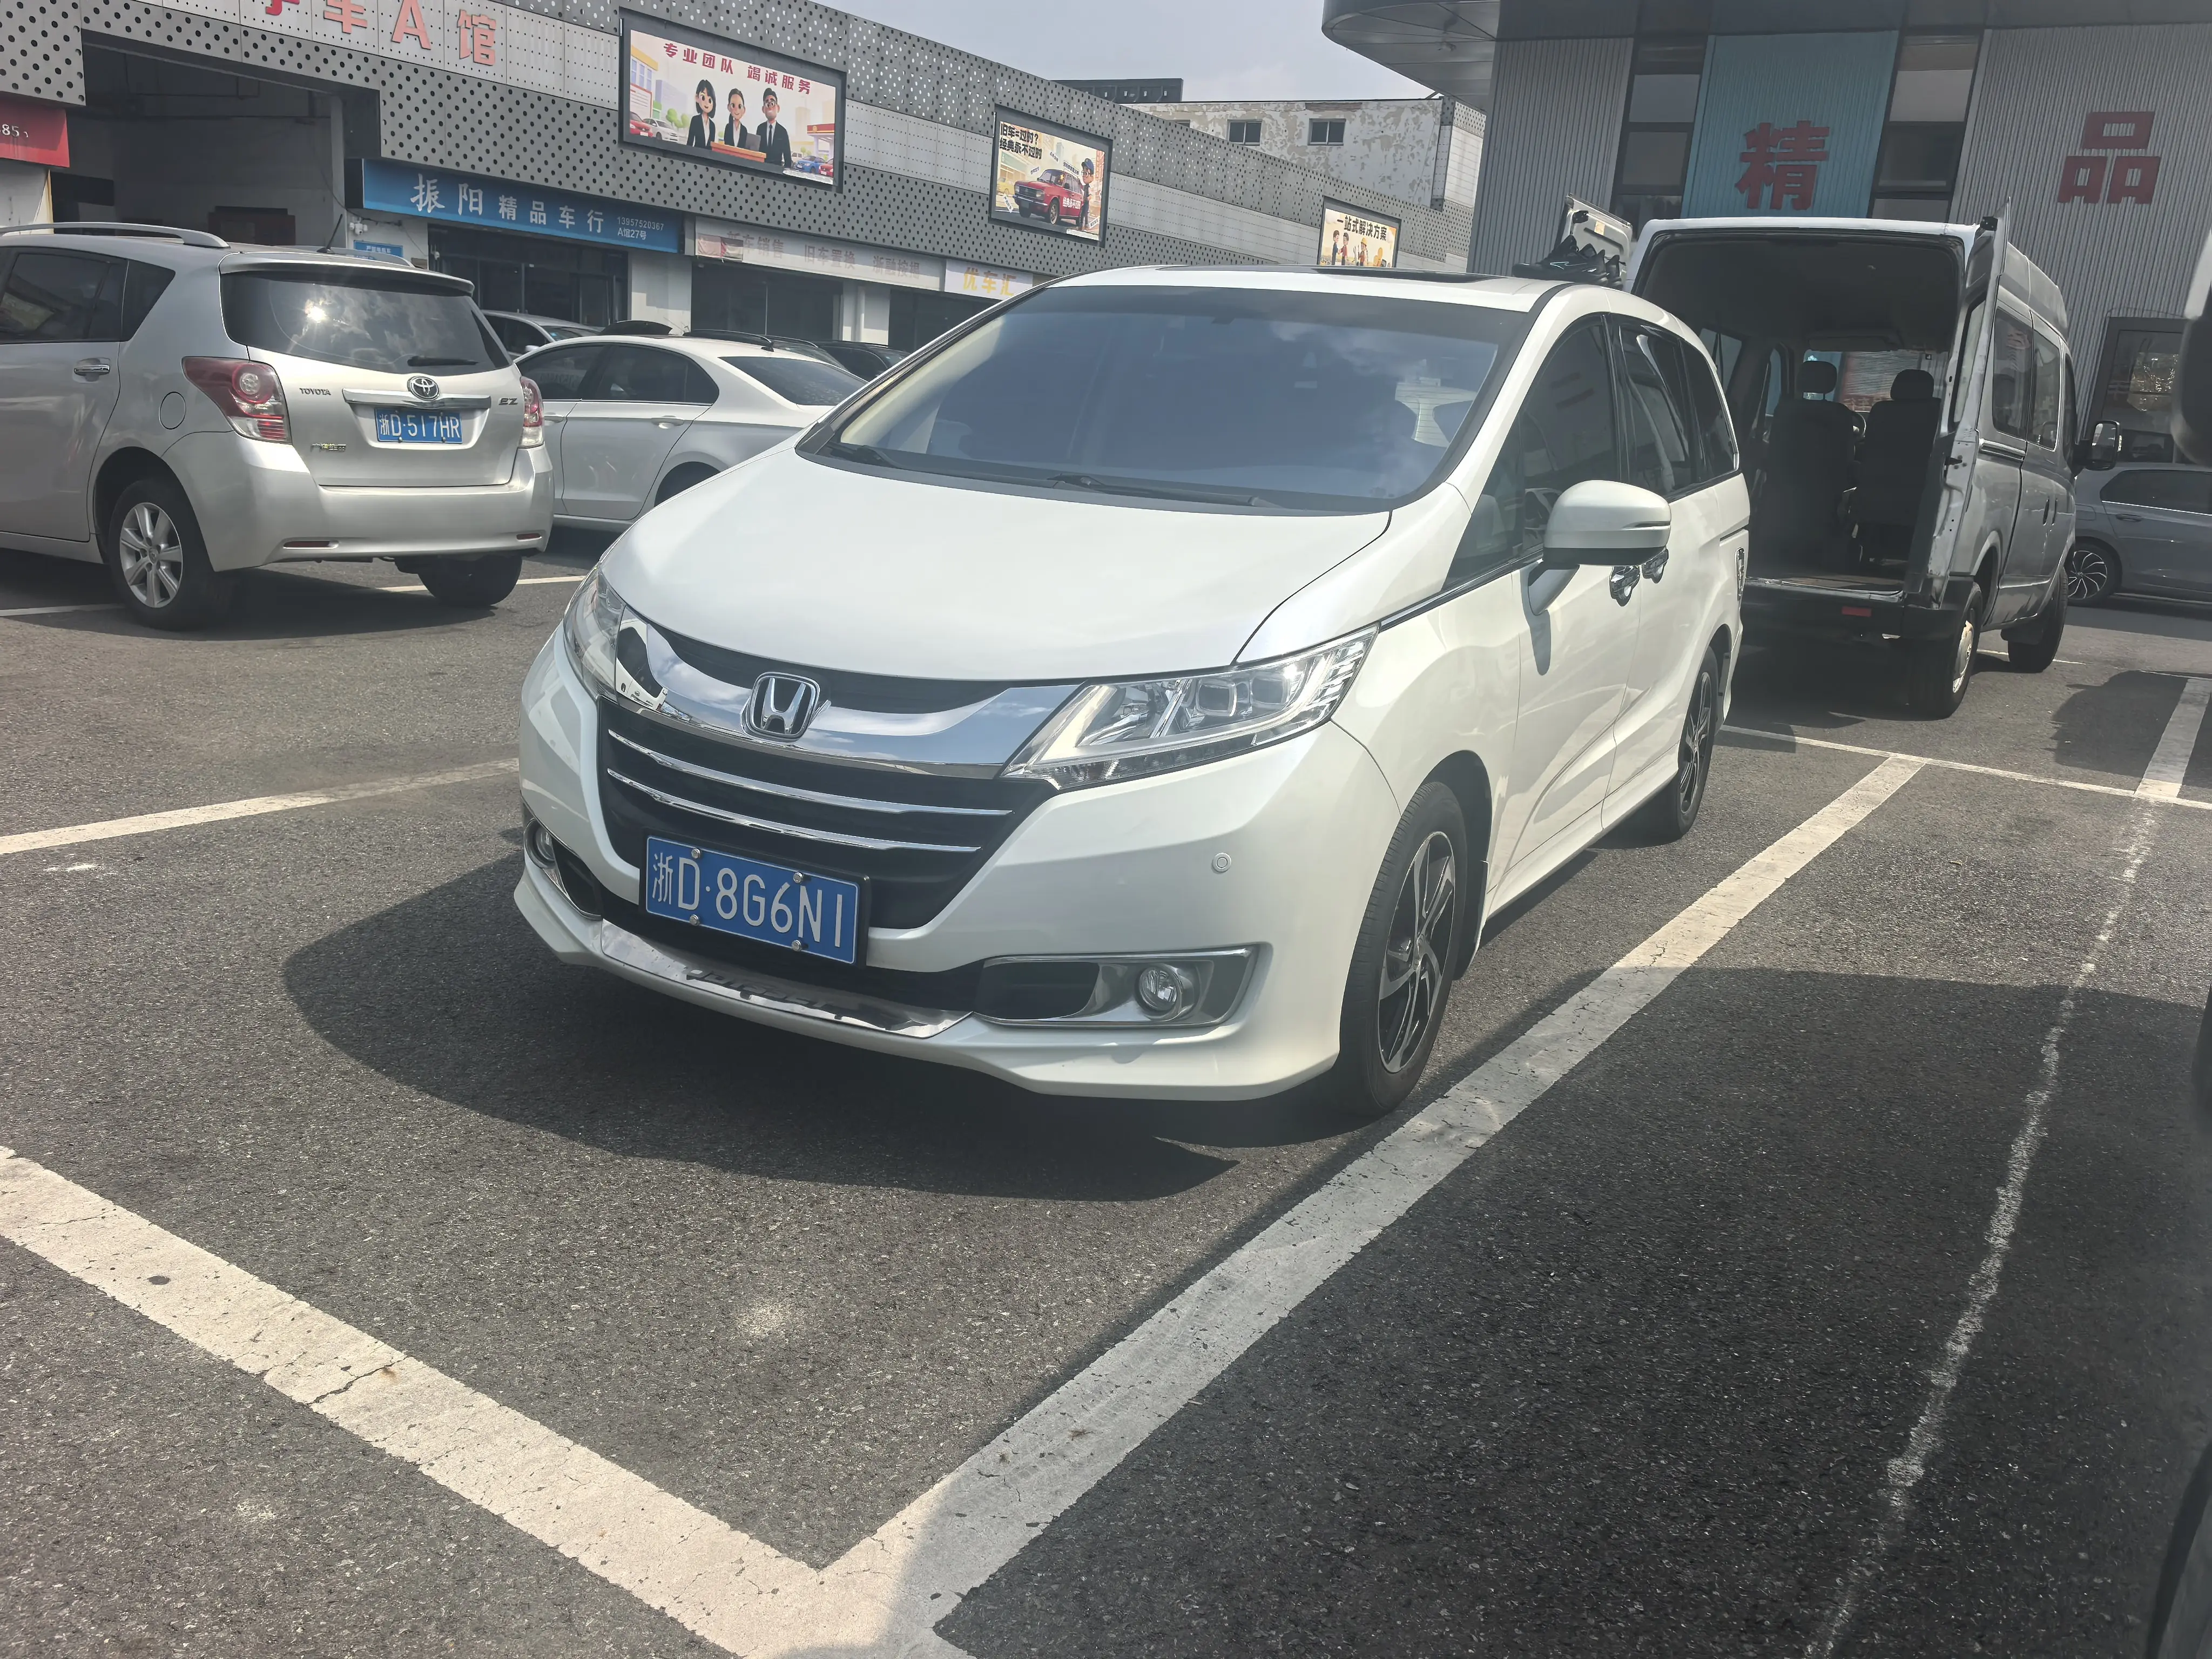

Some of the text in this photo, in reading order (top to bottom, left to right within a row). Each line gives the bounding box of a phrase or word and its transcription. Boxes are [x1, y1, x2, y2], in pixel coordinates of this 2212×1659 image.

[663, 43, 811, 95] 专业团队 竭诚服务
[1000, 137, 1042, 160] 经典永不过时
[617, 216, 664, 231] 13957520367
[617, 227, 646, 240] A馆27号
[1337, 215, 1387, 241] 一站式解决方案
[805, 244, 855, 270] 旧车置换
[963, 266, 1017, 296] 优车汇
[652, 852, 842, 948] 浙D·8G6N1
